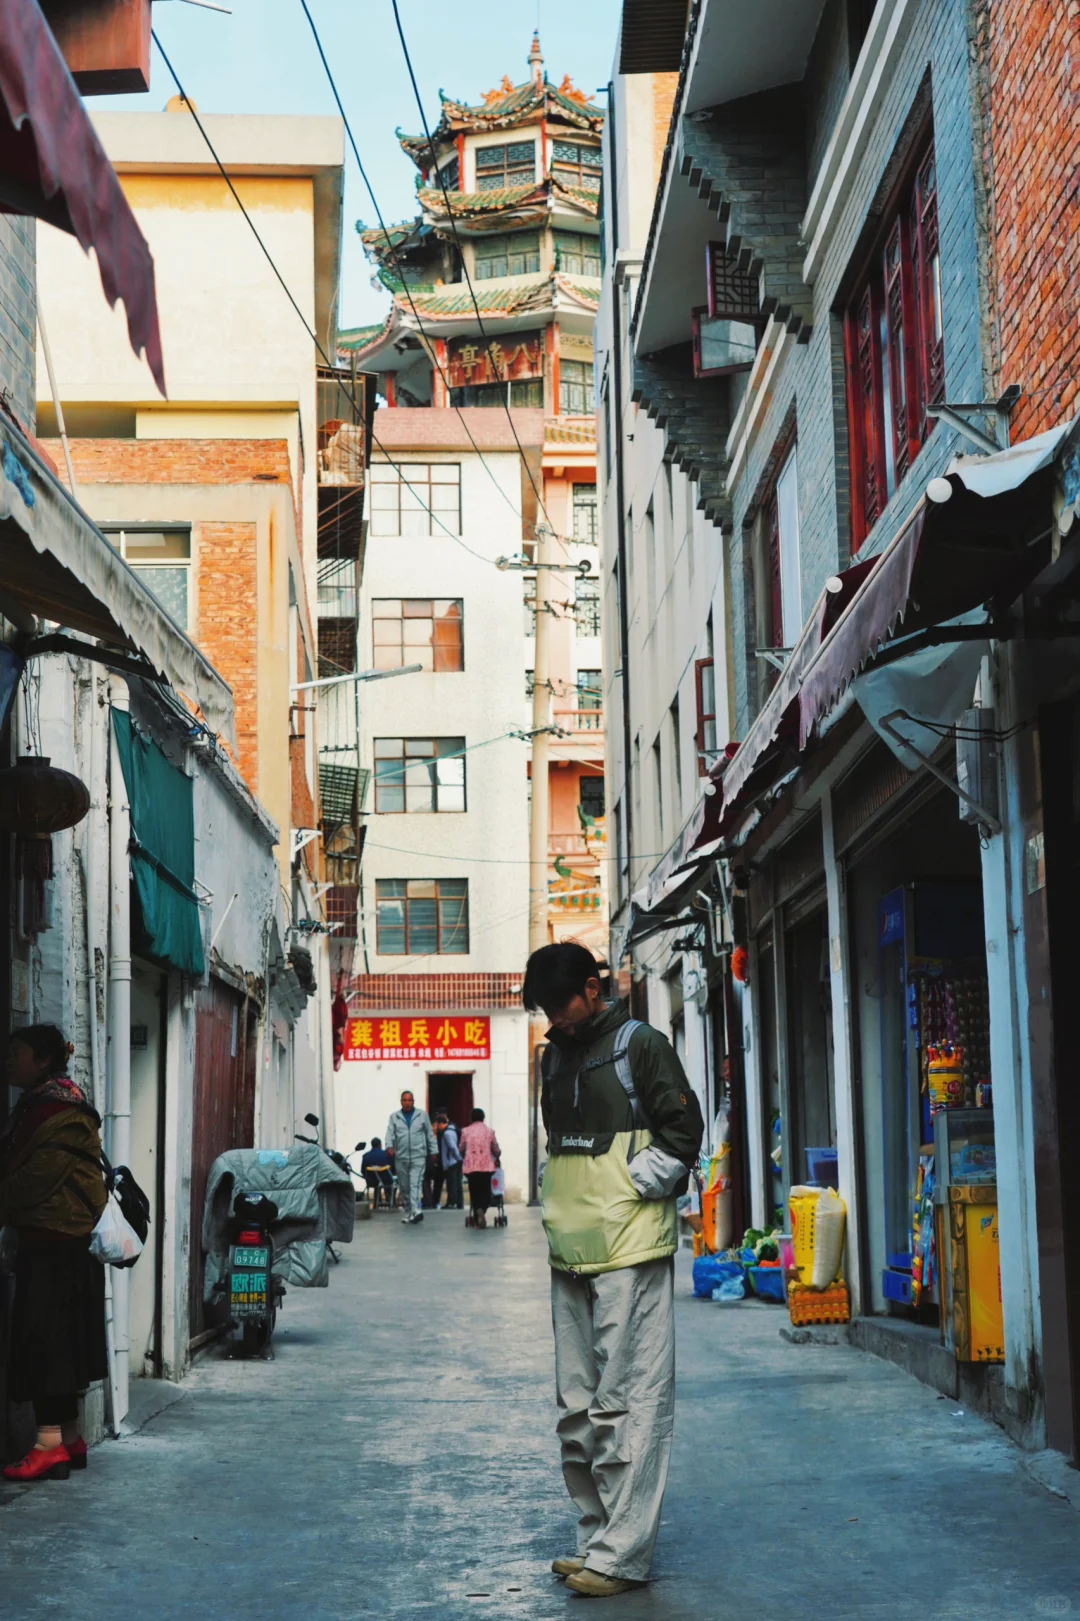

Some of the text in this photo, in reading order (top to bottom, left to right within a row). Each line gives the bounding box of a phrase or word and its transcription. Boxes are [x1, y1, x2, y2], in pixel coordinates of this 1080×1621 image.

[458, 340, 538, 379] 八角亭
[351, 1019, 487, 1047] 龚祖兵小吃
[561, 1136, 595, 1148] Timberland
[236, 1256, 265, 1264] 09748
[231, 1272, 267, 1291] 欧派
